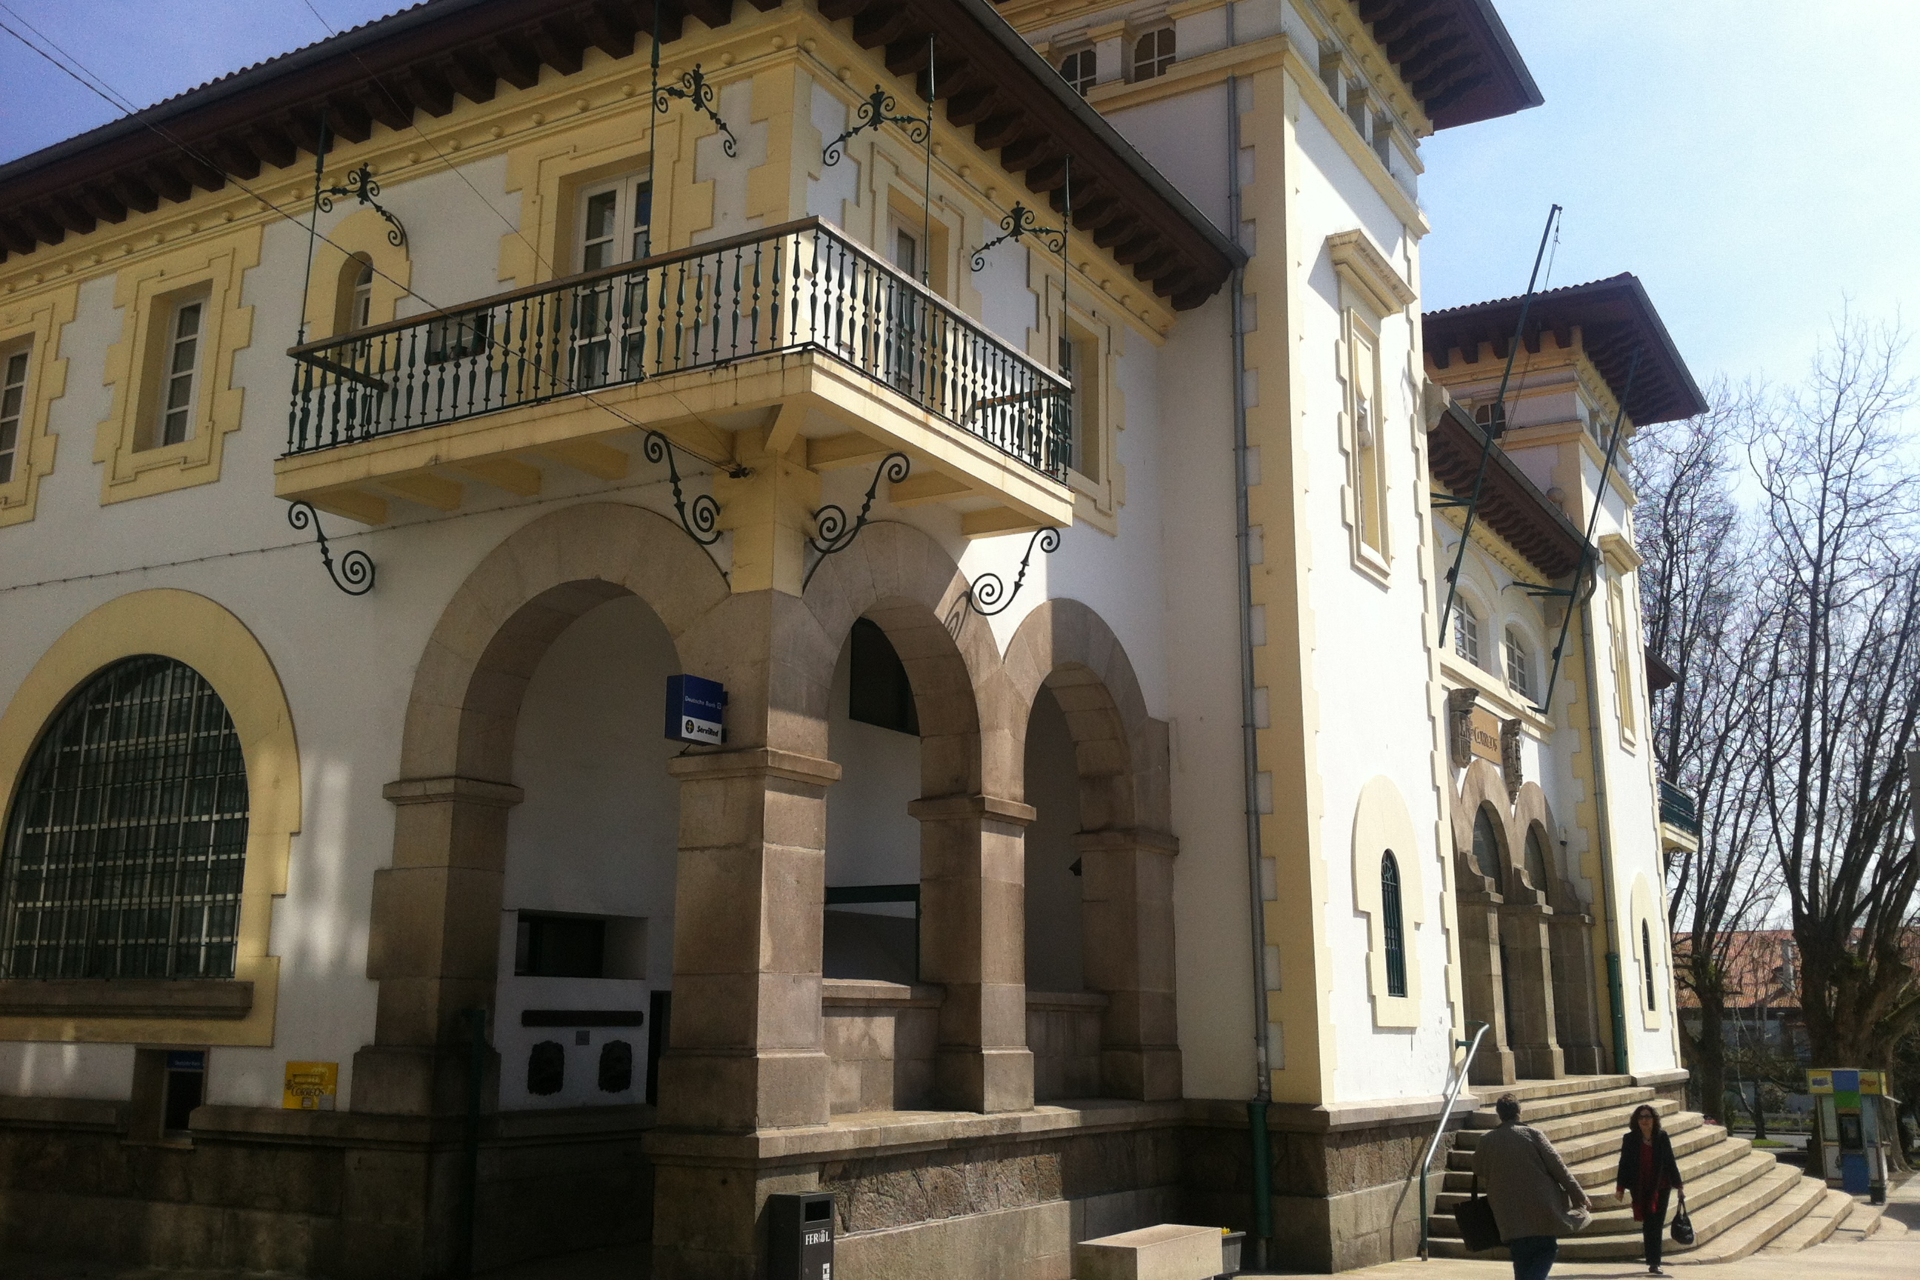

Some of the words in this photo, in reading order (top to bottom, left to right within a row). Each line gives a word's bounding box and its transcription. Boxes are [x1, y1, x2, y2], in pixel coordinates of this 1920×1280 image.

[684, 695, 705, 706] Deutsche
[705, 700, 716, 709] Bank
[696, 725, 719, 737] ServiRed
[1473, 726, 1498, 752] CORREOS
[291, 1086, 324, 1097] CORREOS
